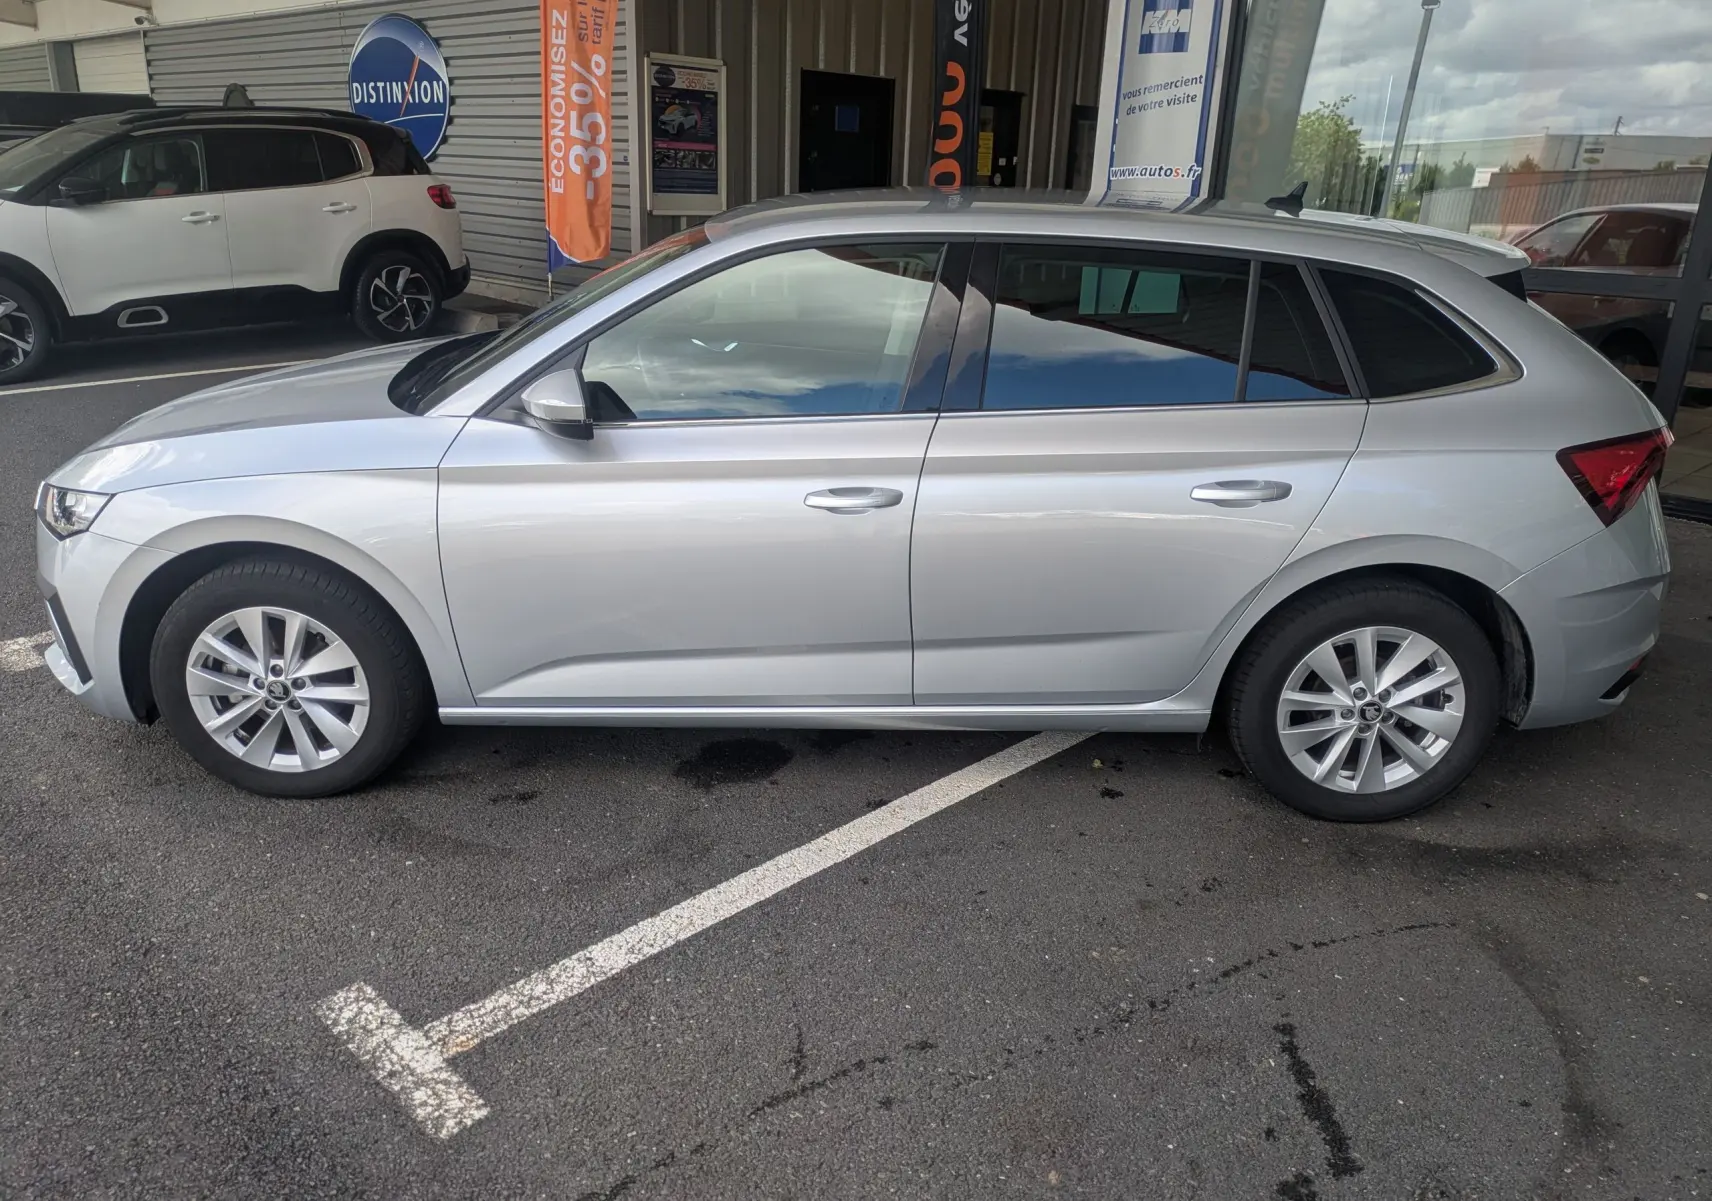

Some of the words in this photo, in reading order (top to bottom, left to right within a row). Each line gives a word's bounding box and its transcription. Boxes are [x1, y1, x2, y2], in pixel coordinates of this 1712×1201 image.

[578, 12, 589, 44] sur
[592, 6, 605, 45] tarif
[352, 80, 444, 104] DISTINXION
[549, 9, 568, 194] ÉCONOMISEZ
[1122, 87, 1142, 101] vous
[1143, 74, 1204, 95] remercient
[1126, 104, 1137, 116] de
[1138, 100, 1164, 113] votre
[1166, 92, 1198, 107] visite
[569, 53, 608, 201] -35%
[1110, 164, 1200, 179] www.autos.fr
